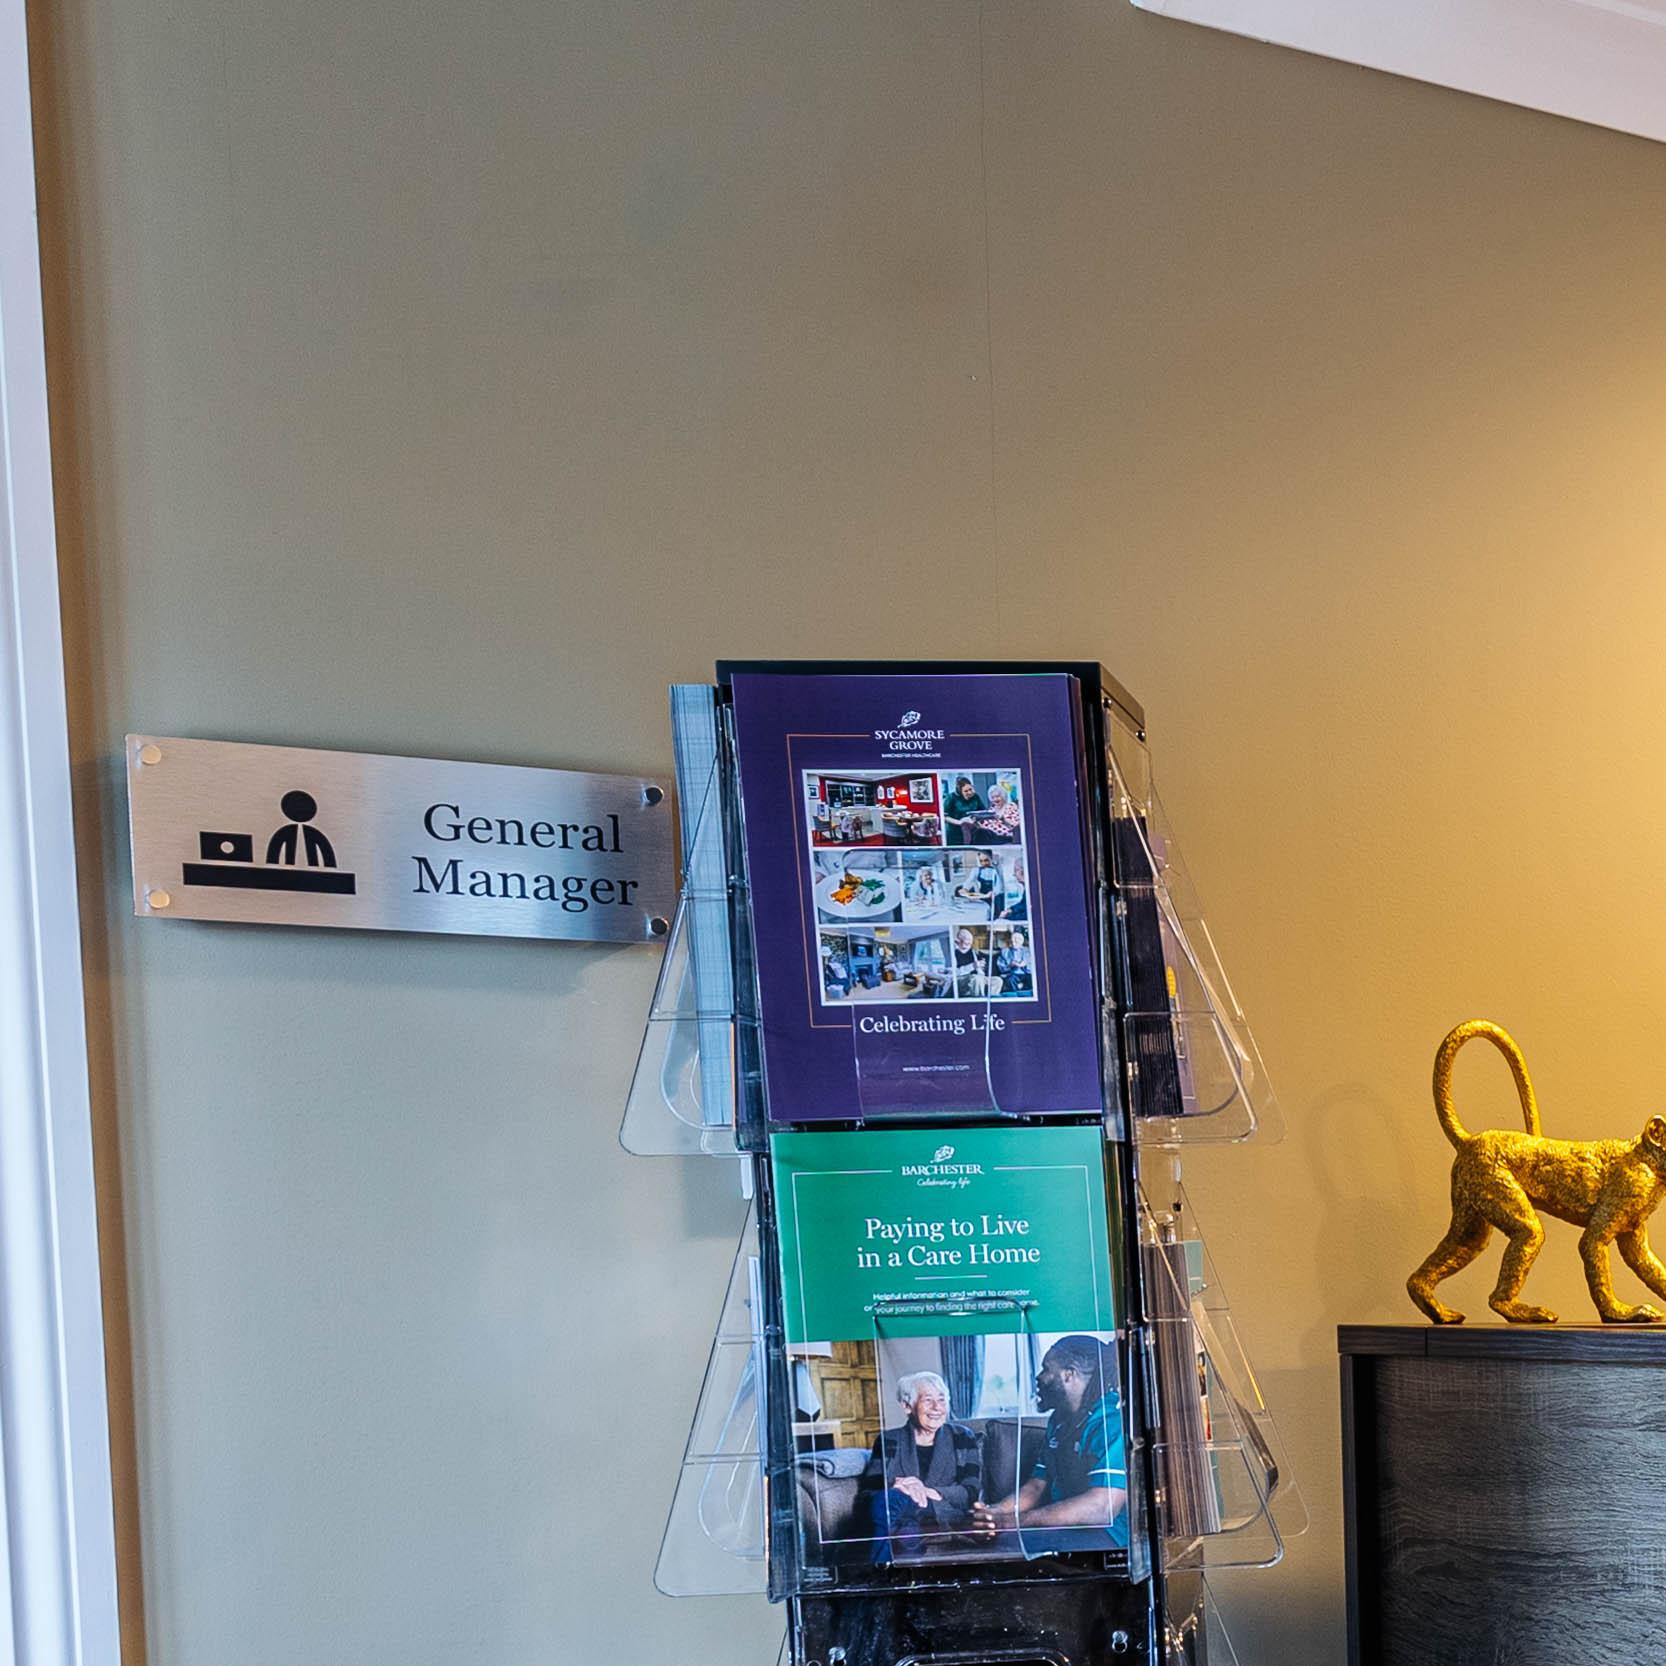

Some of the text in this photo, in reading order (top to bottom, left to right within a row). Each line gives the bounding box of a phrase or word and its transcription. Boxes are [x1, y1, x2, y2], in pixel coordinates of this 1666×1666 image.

[875, 730, 945, 739] SYCAMORE
[890, 741, 932, 750] GROVE
[424, 803, 622, 853] General
[412, 855, 639, 912] Manager
[860, 1014, 1005, 1035] Celebrating Life
[902, 1164, 984, 1175] BARCHESTER
[865, 1215, 1029, 1244] Paying to Live
[857, 1243, 1041, 1268] in a Care Home
